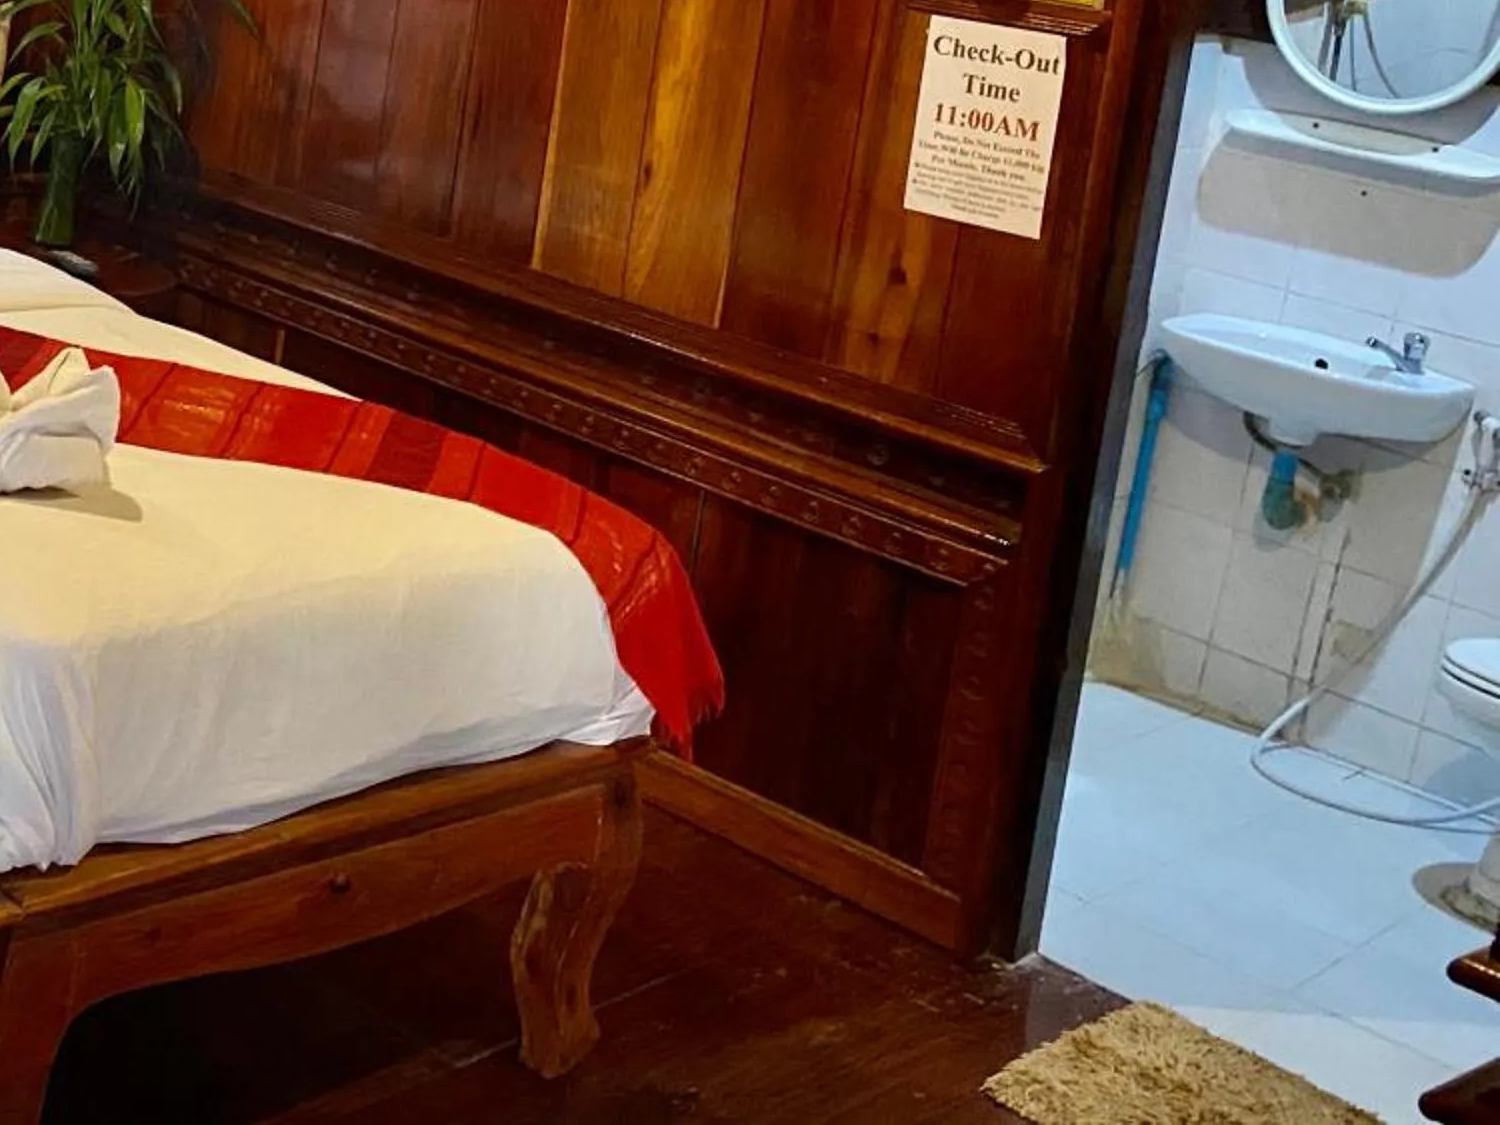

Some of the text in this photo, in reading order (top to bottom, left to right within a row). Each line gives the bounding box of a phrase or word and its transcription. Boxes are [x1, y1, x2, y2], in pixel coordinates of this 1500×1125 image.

[933, 34, 1061, 75] Check-Out
[962, 72, 1021, 103] Time
[934, 102, 1041, 142] 11:00AM
